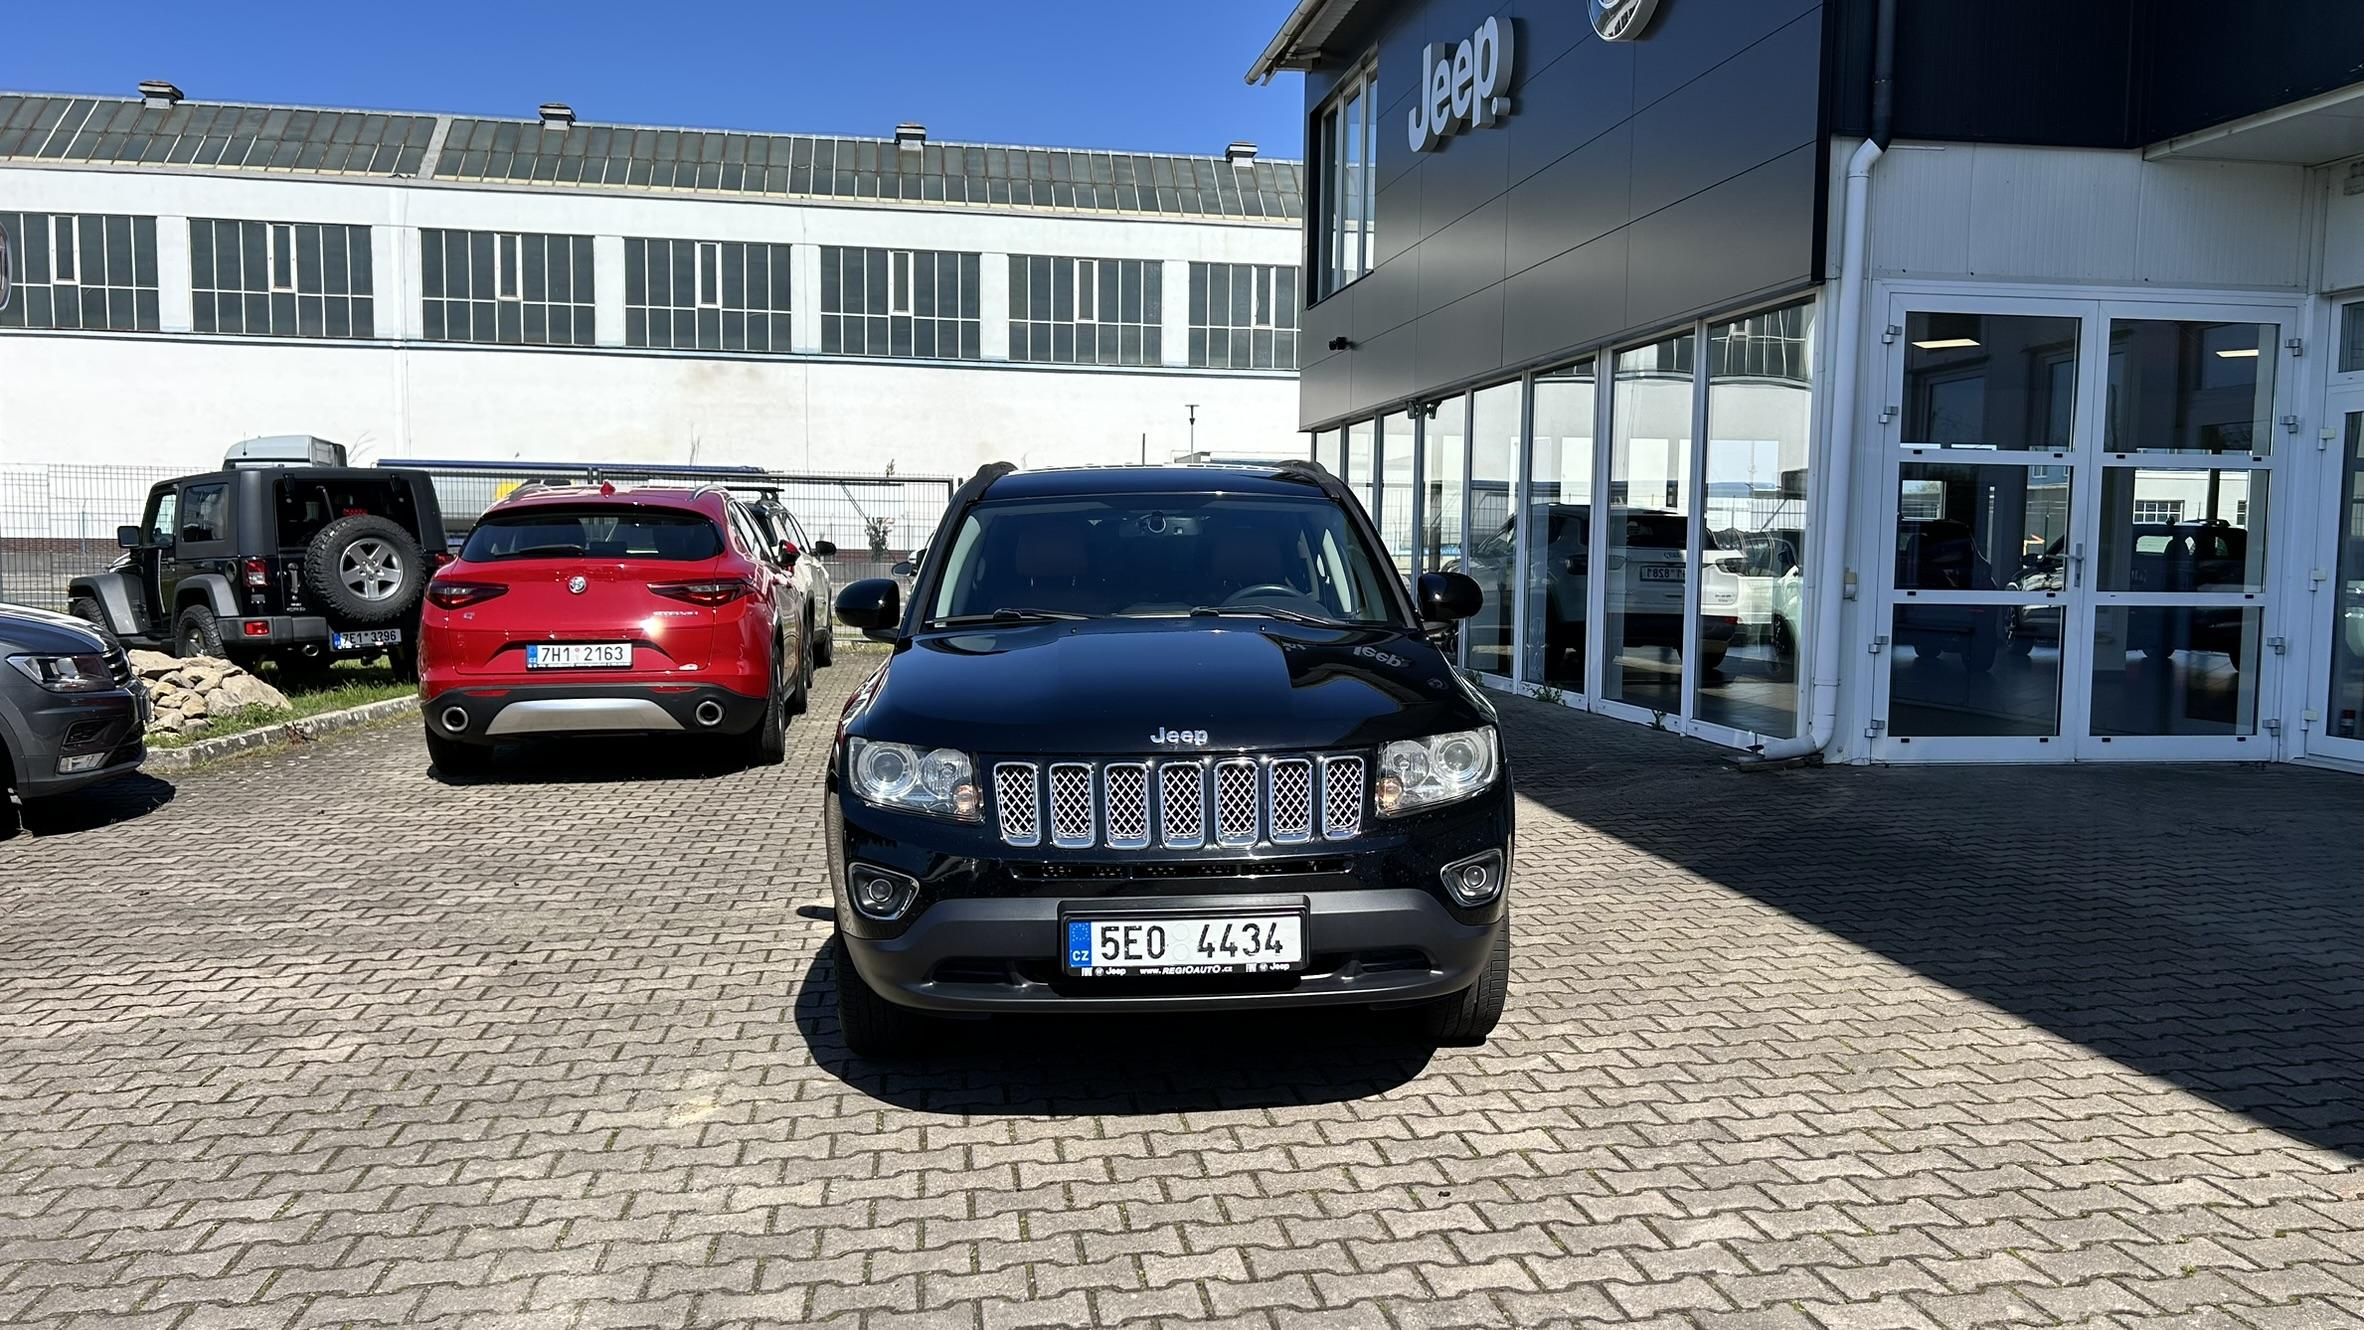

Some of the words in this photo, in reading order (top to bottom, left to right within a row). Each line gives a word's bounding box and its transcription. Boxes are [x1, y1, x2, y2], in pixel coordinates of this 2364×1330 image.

[1408, 16, 1500, 152] Jeep
[541, 647, 570, 662] 7H1
[584, 646, 623, 661] 2163
[1150, 727, 1208, 746] Jeep
[1072, 950, 1089, 961] CZ
[1101, 925, 1166, 960] 5E0
[1197, 922, 1283, 958] 4434
[1105, 967, 1126, 976] Jeep
[1139, 965, 1233, 975] www.REGIOAUTO.cz
[1269, 962, 1290, 971] Jeep
